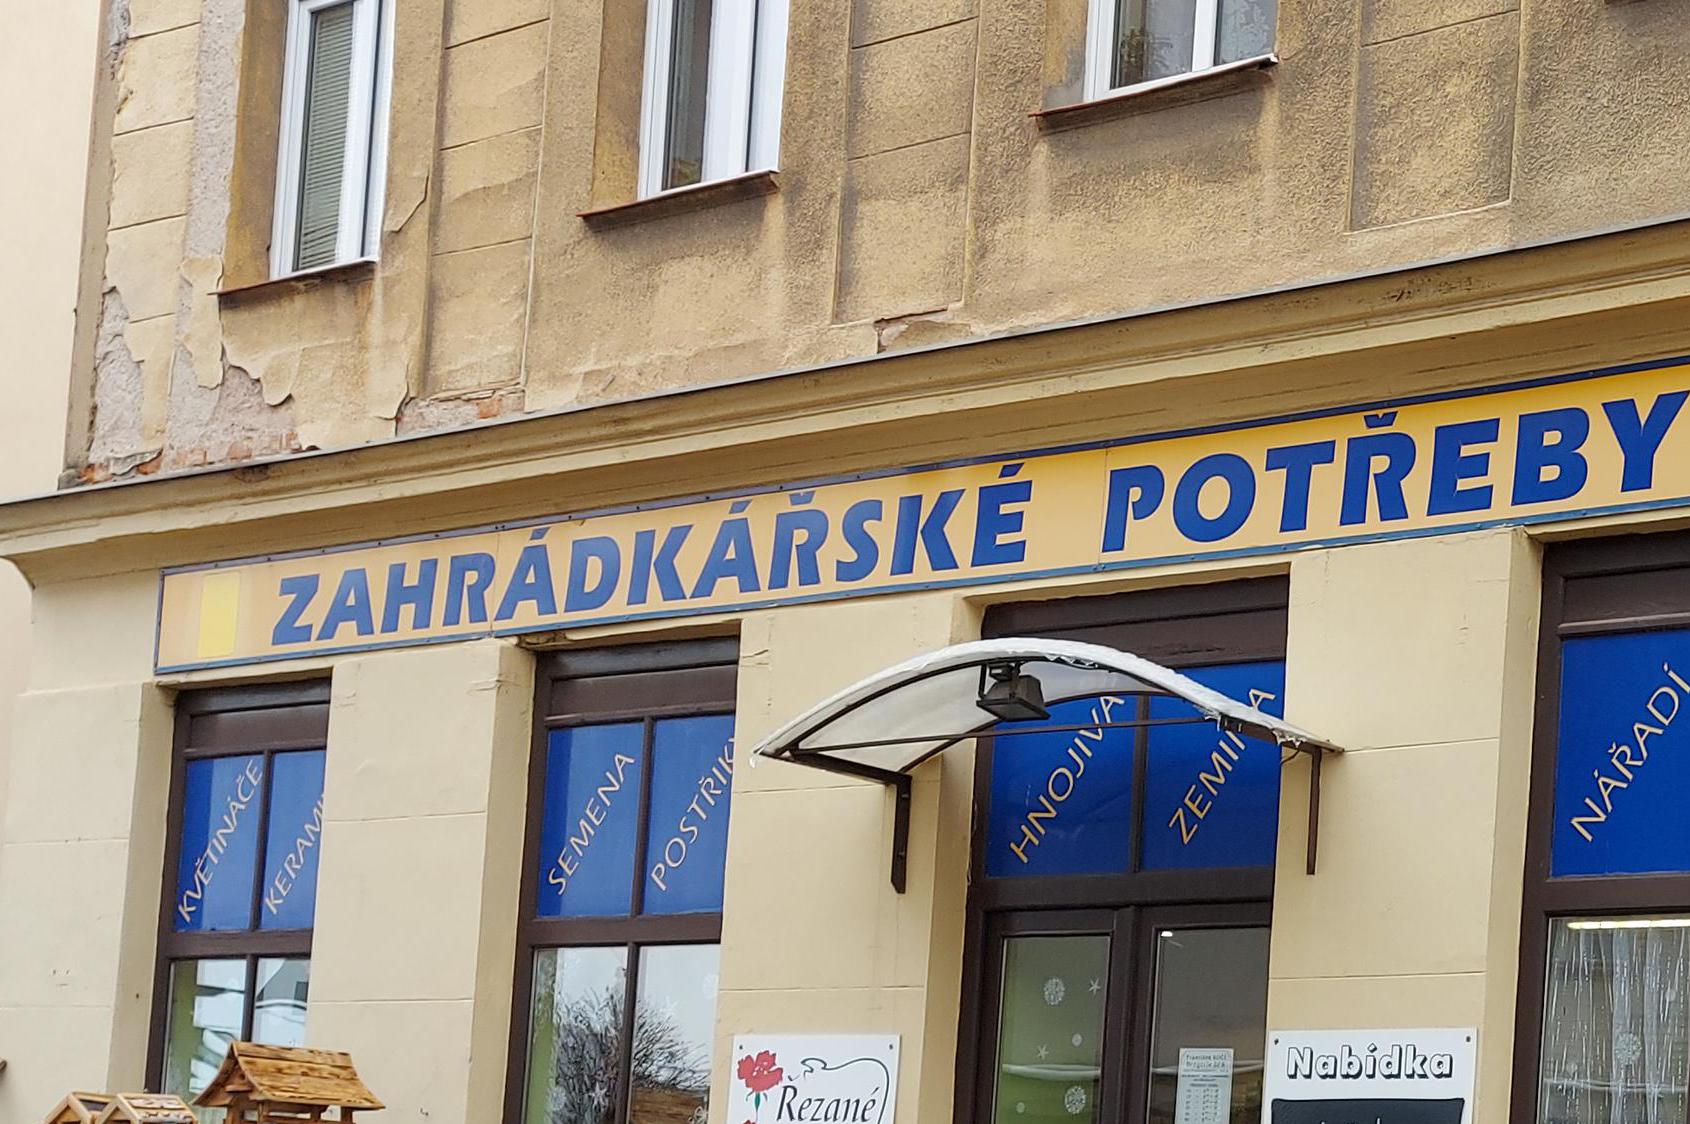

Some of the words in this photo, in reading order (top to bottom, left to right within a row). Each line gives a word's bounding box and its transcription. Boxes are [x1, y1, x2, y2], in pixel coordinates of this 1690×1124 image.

[271, 462, 1034, 646] ZAHRÁDKÁŘSKÉ
[177, 759, 263, 923] KVĚTINÁČE
[548, 752, 635, 895] SEMENA
[651, 737, 735, 892] POSTŘIK
[1009, 694, 1125, 864] HNOJIVA
[776, 1075, 880, 1123] Řezané
[1286, 1043, 1454, 1080] Nabídka
